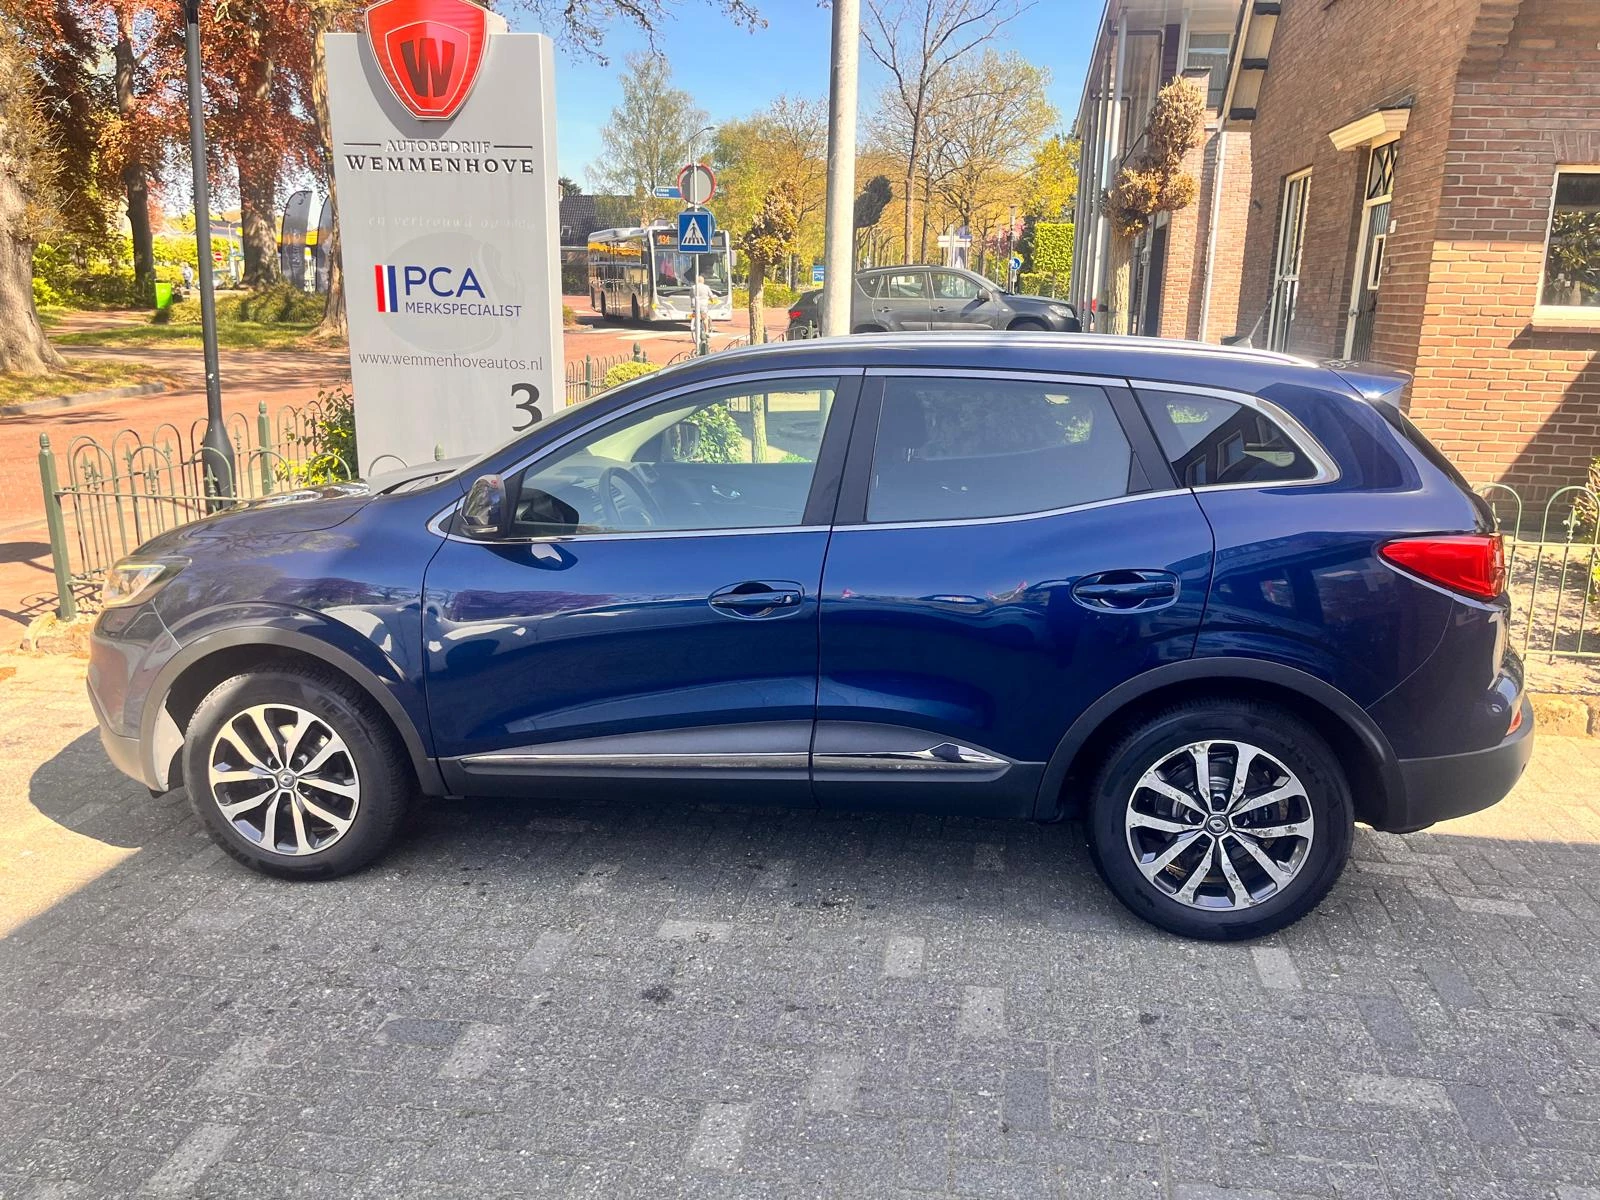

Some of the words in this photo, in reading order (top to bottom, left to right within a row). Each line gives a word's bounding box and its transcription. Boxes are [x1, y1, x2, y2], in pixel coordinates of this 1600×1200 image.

[385, 139, 491, 154] AUTOBEDRIJF
[345, 155, 534, 174] WEMMENHOVE
[404, 266, 486, 299] PCA
[405, 302, 522, 317] MERKSPECIALIST
[358, 353, 543, 371] www.wemmenhoveautos.nl
[511, 382, 543, 432] 3
